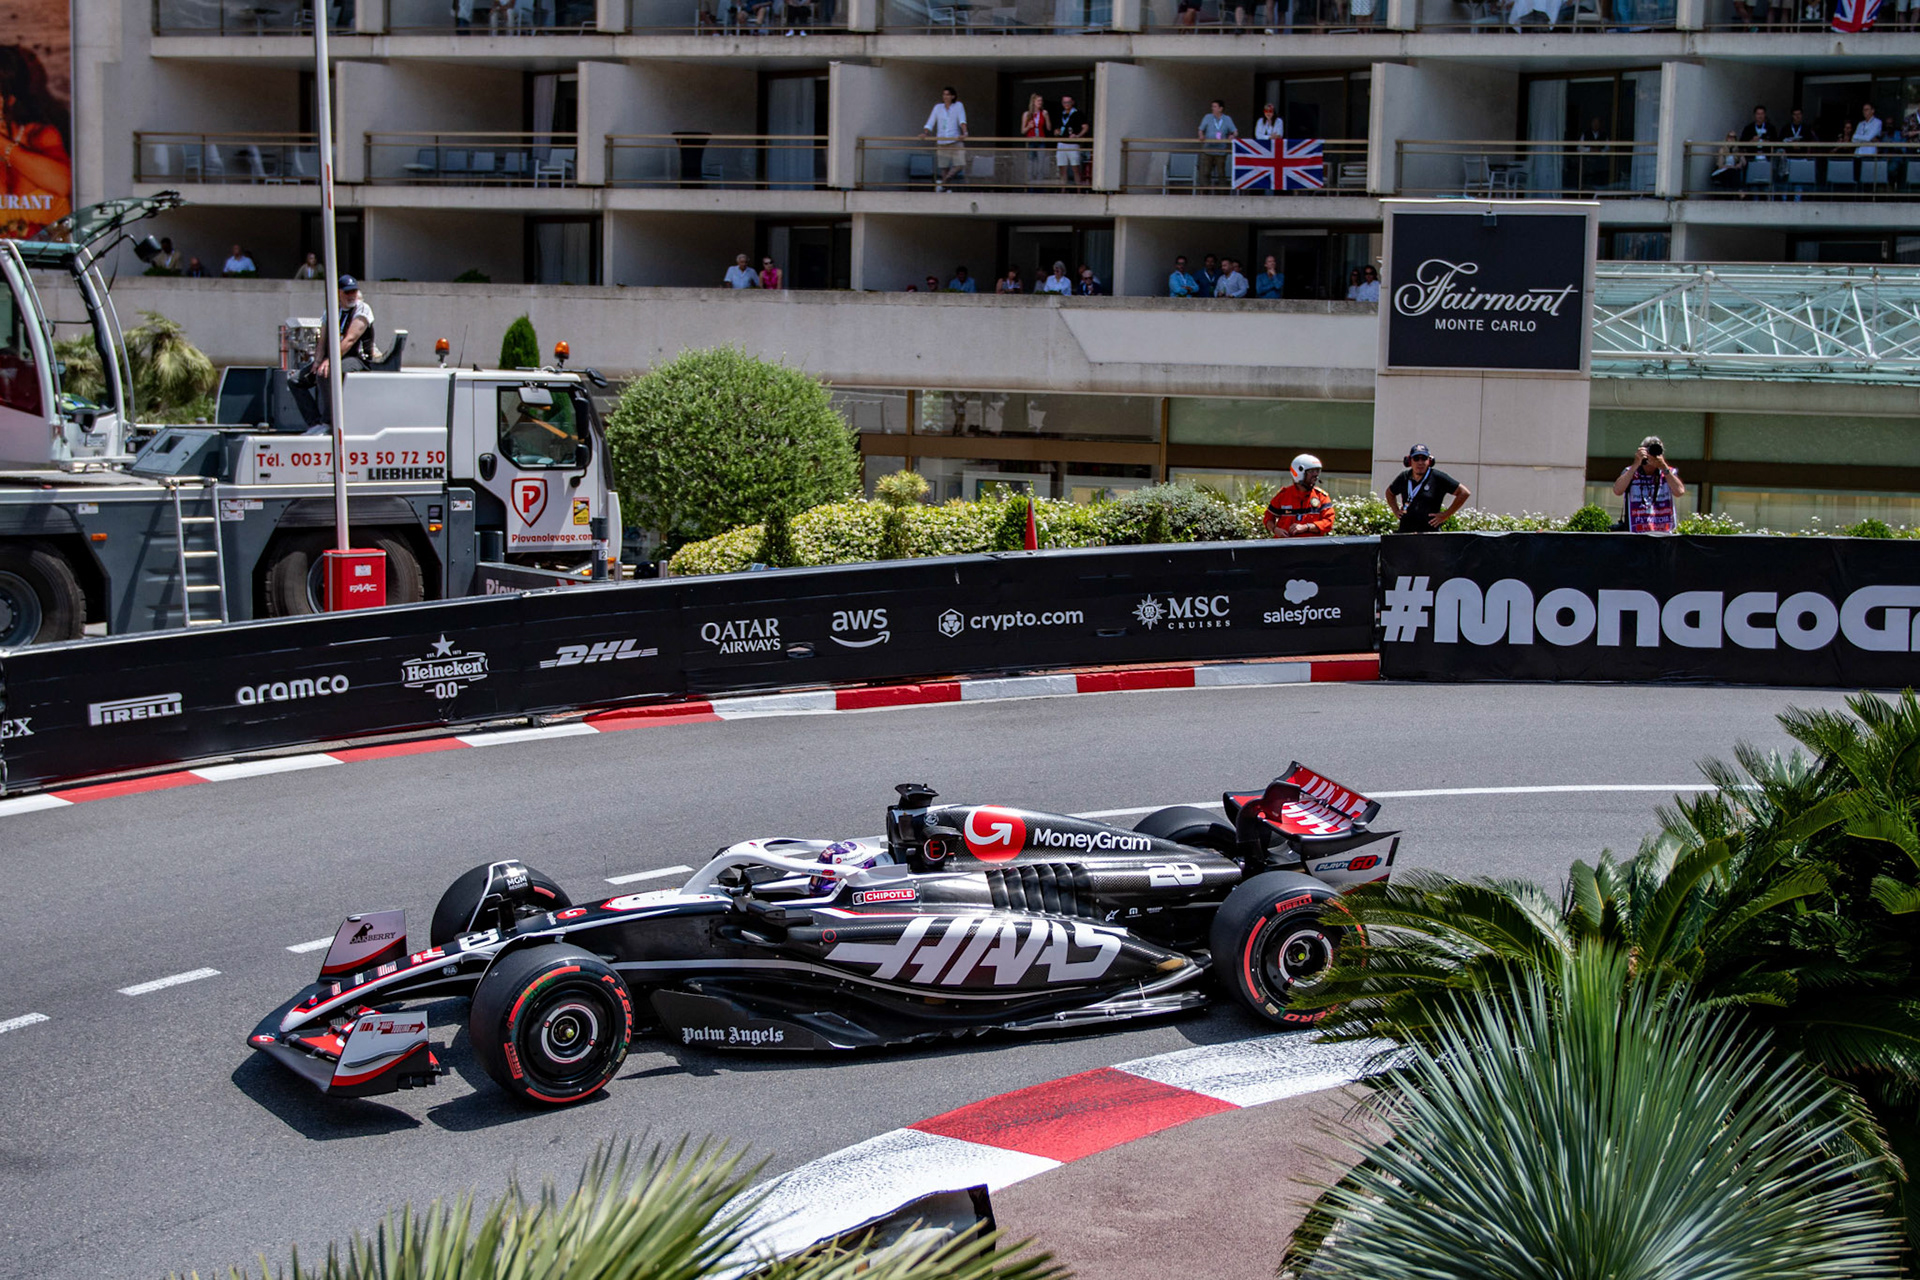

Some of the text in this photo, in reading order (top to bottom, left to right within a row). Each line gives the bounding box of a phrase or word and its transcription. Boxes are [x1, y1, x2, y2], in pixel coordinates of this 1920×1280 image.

[1394, 259, 1578, 316] Fairmont
[1435, 319, 1537, 332] MONTE CARLO
[257, 453, 284, 467] Tél.
[350, 452, 368, 465] 93
[376, 452, 395, 465] 50
[402, 452, 419, 465] 72
[427, 451, 446, 464] 50
[368, 468, 445, 481] LIEBHERR
[350, 584, 377, 593] FAAC
[1168, 595, 1230, 619] MSC
[1263, 605, 1341, 625] salesforce
[1381, 576, 1920, 652] #MonacoG
[832, 608, 888, 632] aws
[970, 610, 1084, 630] crypto.com
[1168, 620, 1231, 630] CRUISES
[701, 618, 780, 645] QATAR
[556, 639, 638, 667] DHL
[720, 638, 781, 655] AIRWAYS
[407, 661, 483, 681] Heineken
[236, 675, 349, 705] aramco
[436, 681, 458, 699] 0.0
[88, 692, 182, 726] PIRELLI
[1033, 828, 1151, 852] MoneyGram
[507, 876, 527, 886] MGM
[1143, 863, 1204, 887] 20
[866, 890, 914, 902] CHIPOTLE
[1275, 894, 1312, 913] PIRELLI
[682, 1026, 784, 1046] Palm Angels
